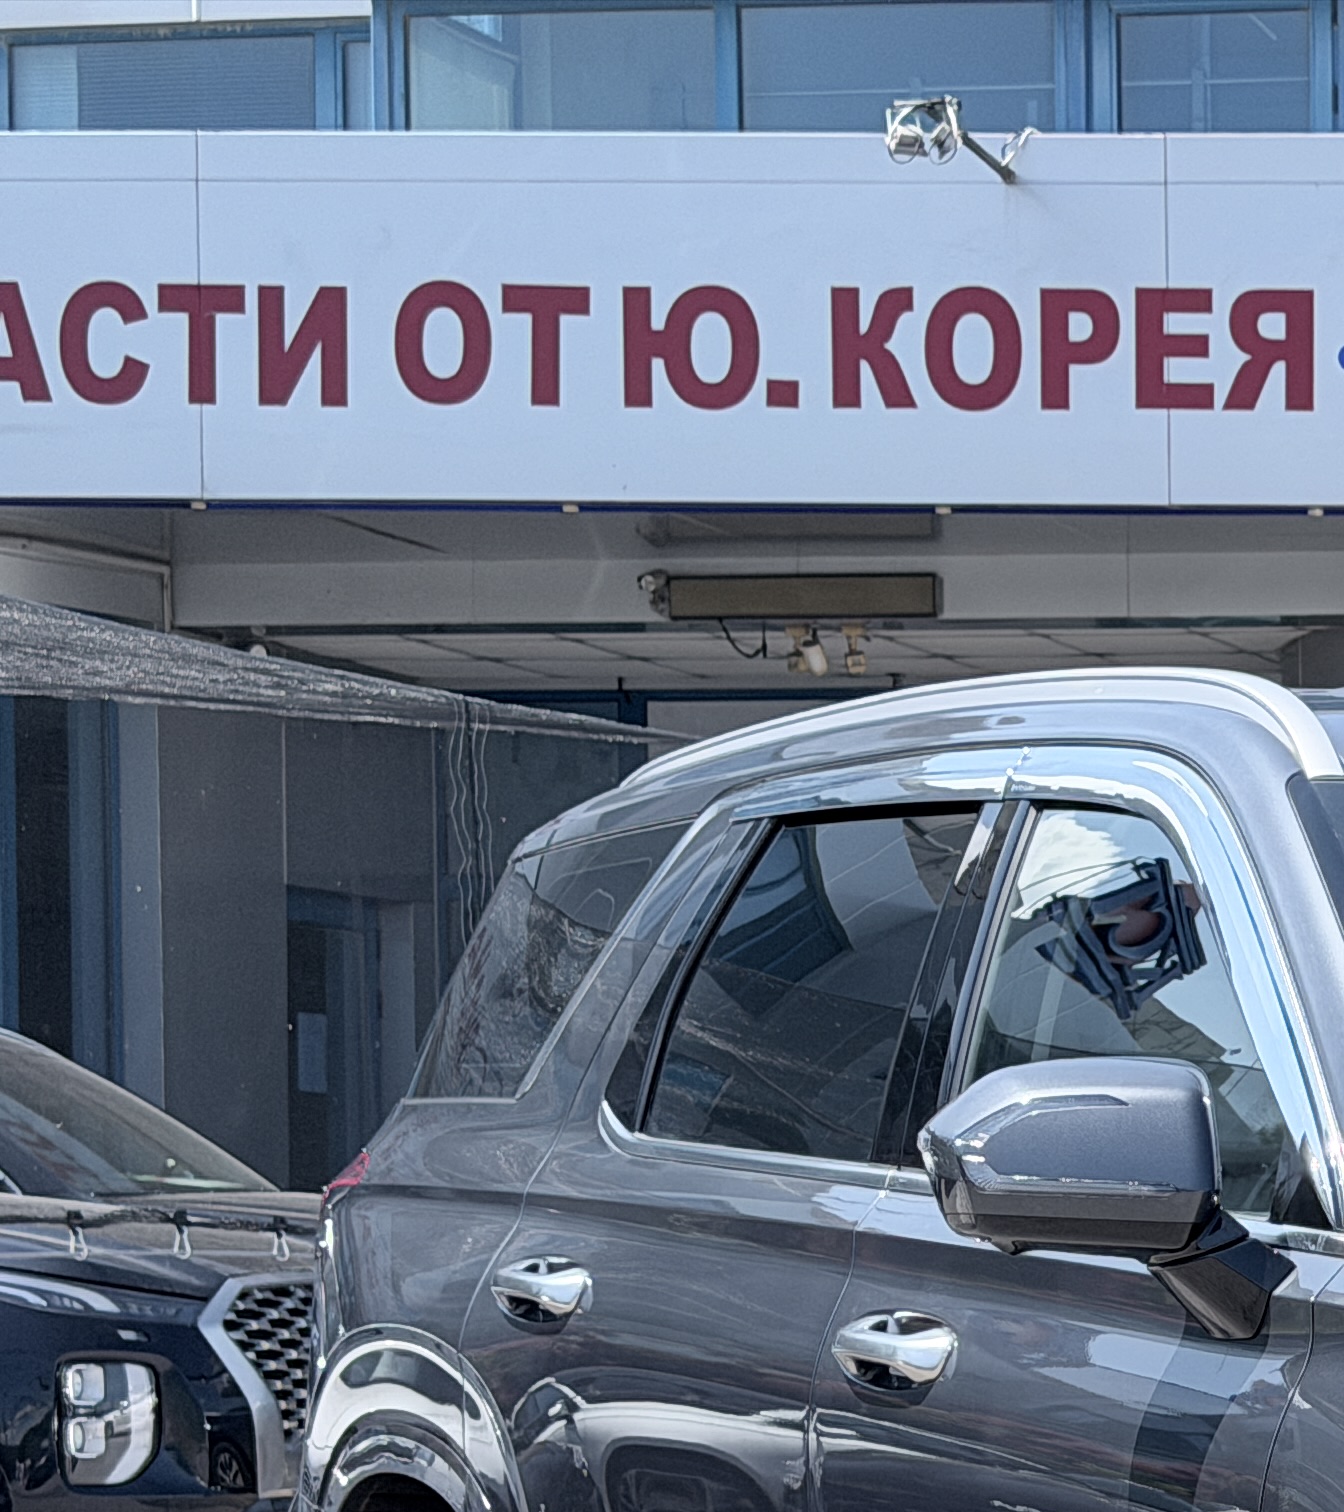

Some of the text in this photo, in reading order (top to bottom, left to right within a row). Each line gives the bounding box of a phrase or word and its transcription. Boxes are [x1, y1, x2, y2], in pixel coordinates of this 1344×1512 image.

[393, 281, 590, 405] ОТ
[621, 285, 799, 409] Ю.
[830, 286, 1315, 411] КОРЕЯ
